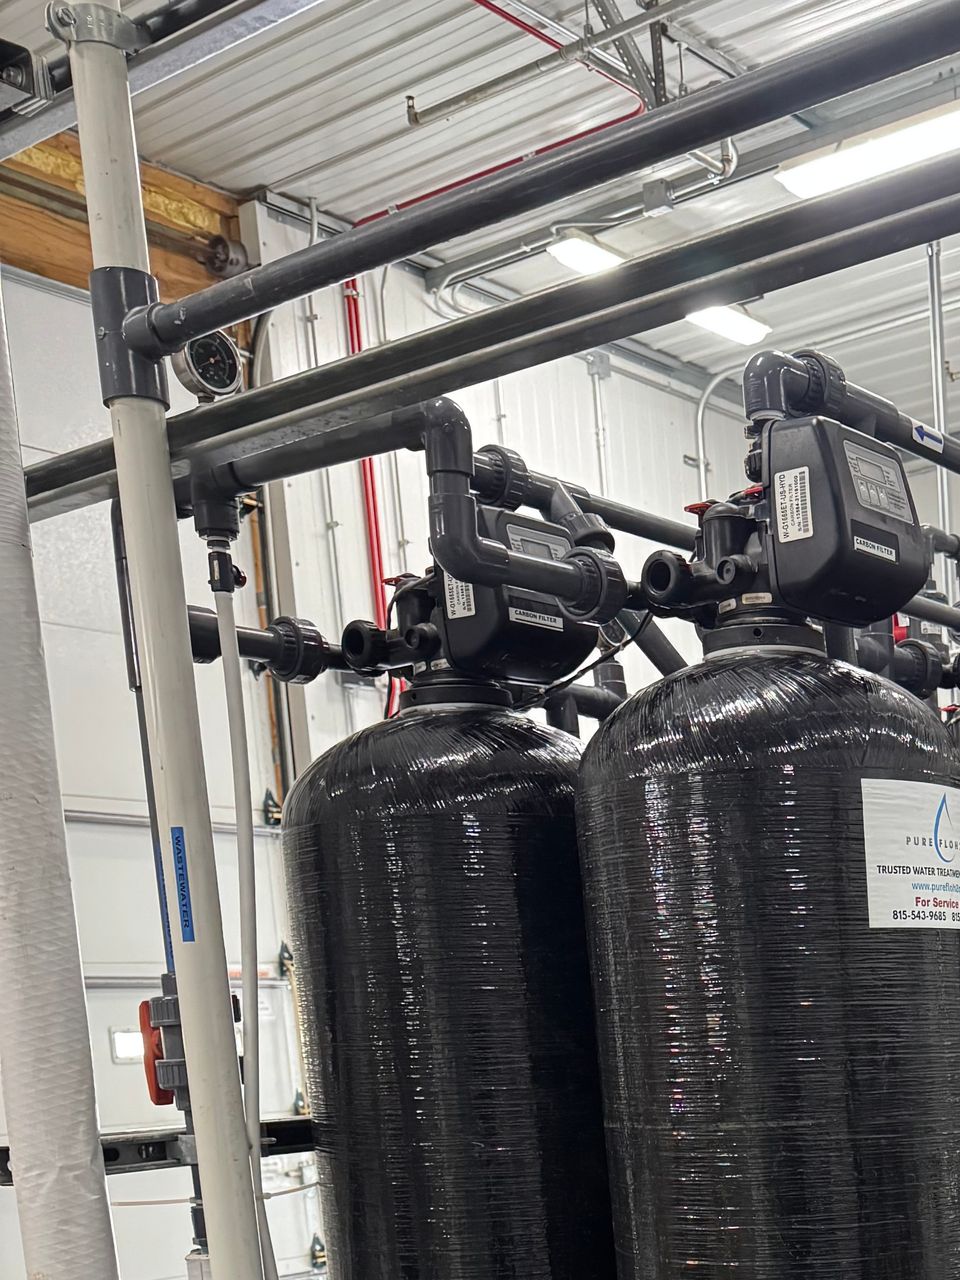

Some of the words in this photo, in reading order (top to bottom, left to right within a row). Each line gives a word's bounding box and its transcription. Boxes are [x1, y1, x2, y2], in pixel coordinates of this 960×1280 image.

[855, 538, 877, 551] CARBON
[876, 544, 894, 556] FILTER
[514, 609, 538, 619] CARBON
[538, 614, 557, 624] FILTER
[906, 837, 933, 847] PURE
[877, 865, 911, 875] TRUSTED
[913, 867, 936, 876] WATER
[173, 835, 190, 929] WASTEWATER
[915, 896, 930, 907] For
[932, 897, 959, 909] Service
[892, 910, 946, 921] 815-543-9685
